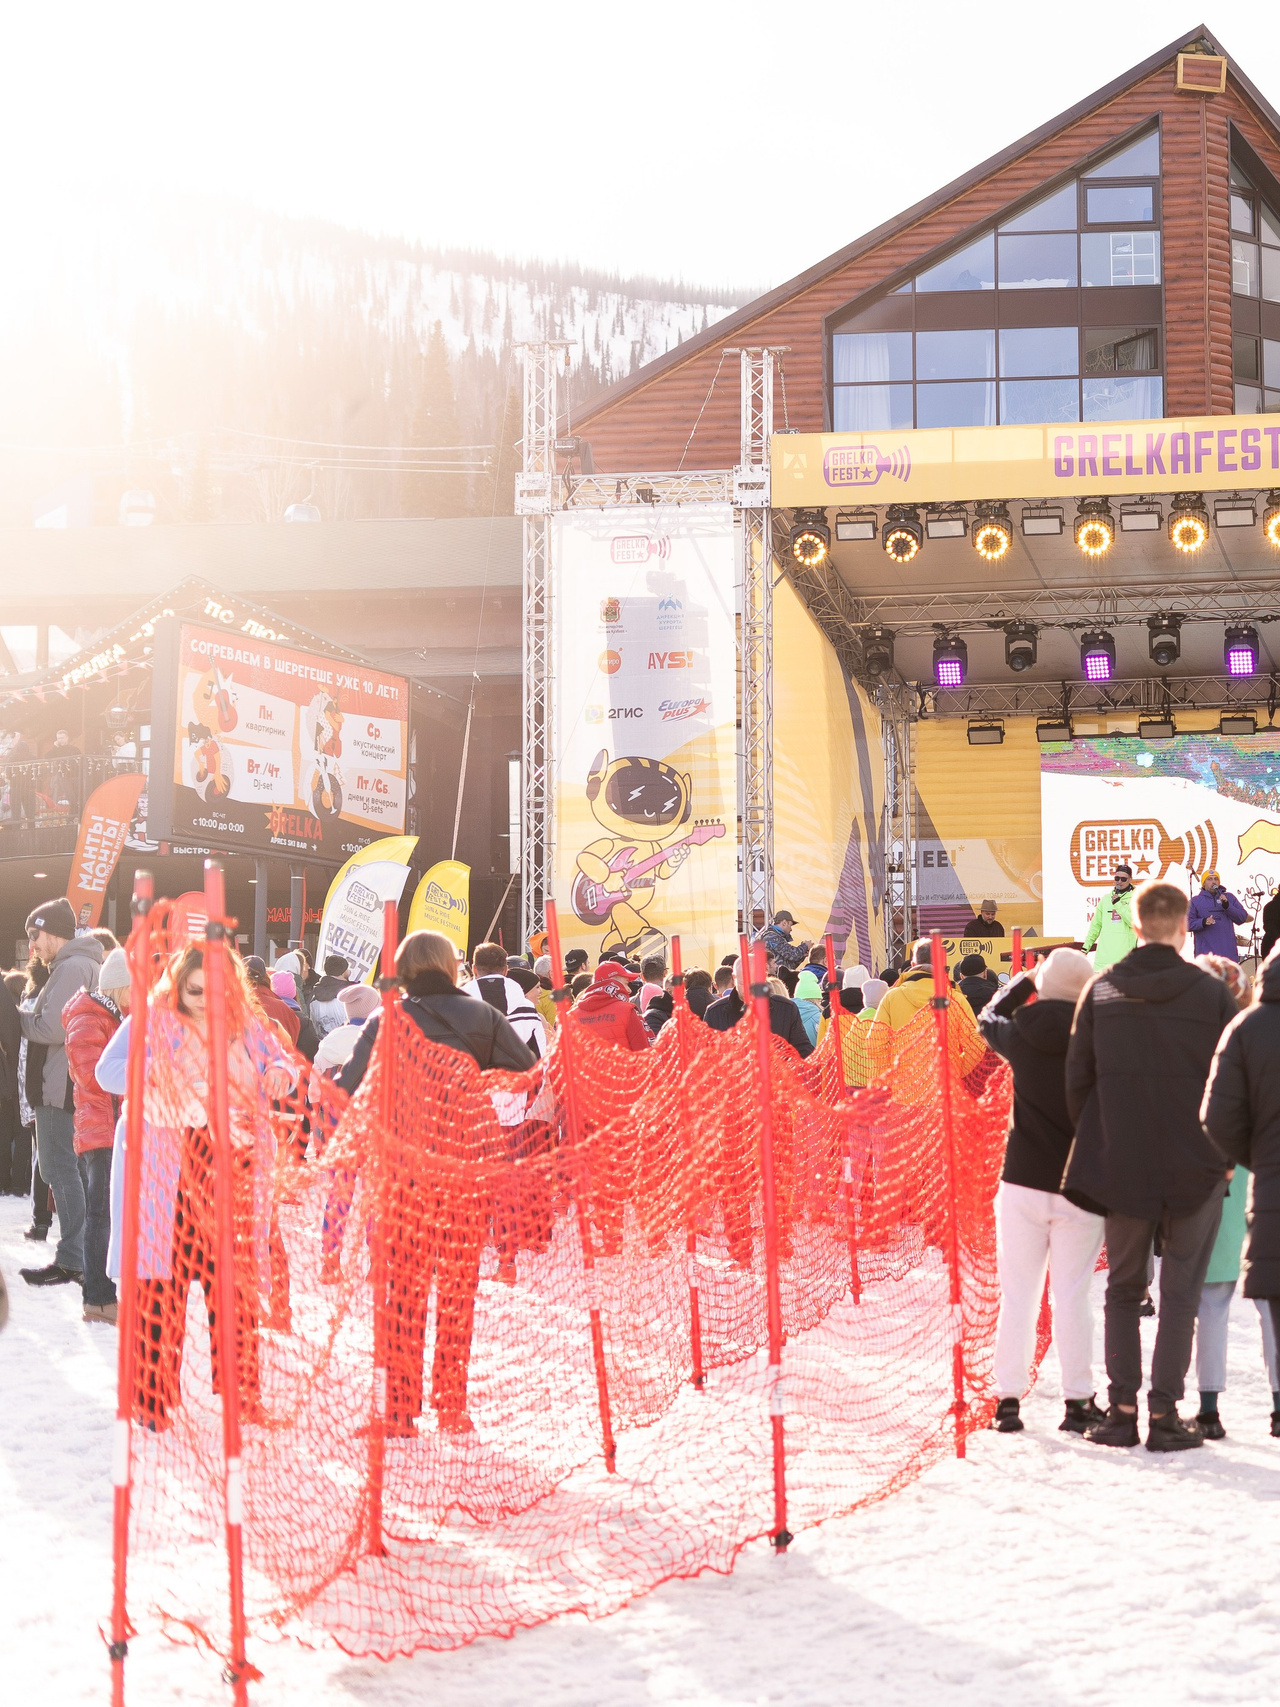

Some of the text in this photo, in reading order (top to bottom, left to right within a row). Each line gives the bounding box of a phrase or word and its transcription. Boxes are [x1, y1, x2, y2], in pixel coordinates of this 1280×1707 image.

[832, 451, 873, 466] GRELKA
[832, 466, 860, 481] FEST
[616, 539, 646, 549] GRELKA
[616, 550, 636, 560] FEST
[647, 651, 693, 669] AYS!
[190, 638, 399, 700] СОГРЕВАЕМ В ШЕРЕГЕШЕ УЖЕ 10 ЛЕТ!
[608, 707, 643, 719] 2ГИС
[245, 721, 286, 737] квартирник
[352, 738, 395, 754] акустический
[360, 749, 387, 761] концерт
[371, 796, 398, 809] вечером
[198, 817, 218, 829] 10:00
[218, 822, 228, 831] до
[228, 822, 245, 833] 0:00
[270, 811, 323, 840] GRELKA
[287, 839, 297, 849] SKI
[297, 839, 307, 850] BAR
[1085, 828, 1154, 852] GRELKA
[77, 815, 104, 889] МАНТЫ
[91, 818, 120, 892] ПОНТЫ
[173, 846, 210, 855] БЫСТРО
[350, 893, 366, 906] FEST
[353, 885, 375, 901] GRELKA
